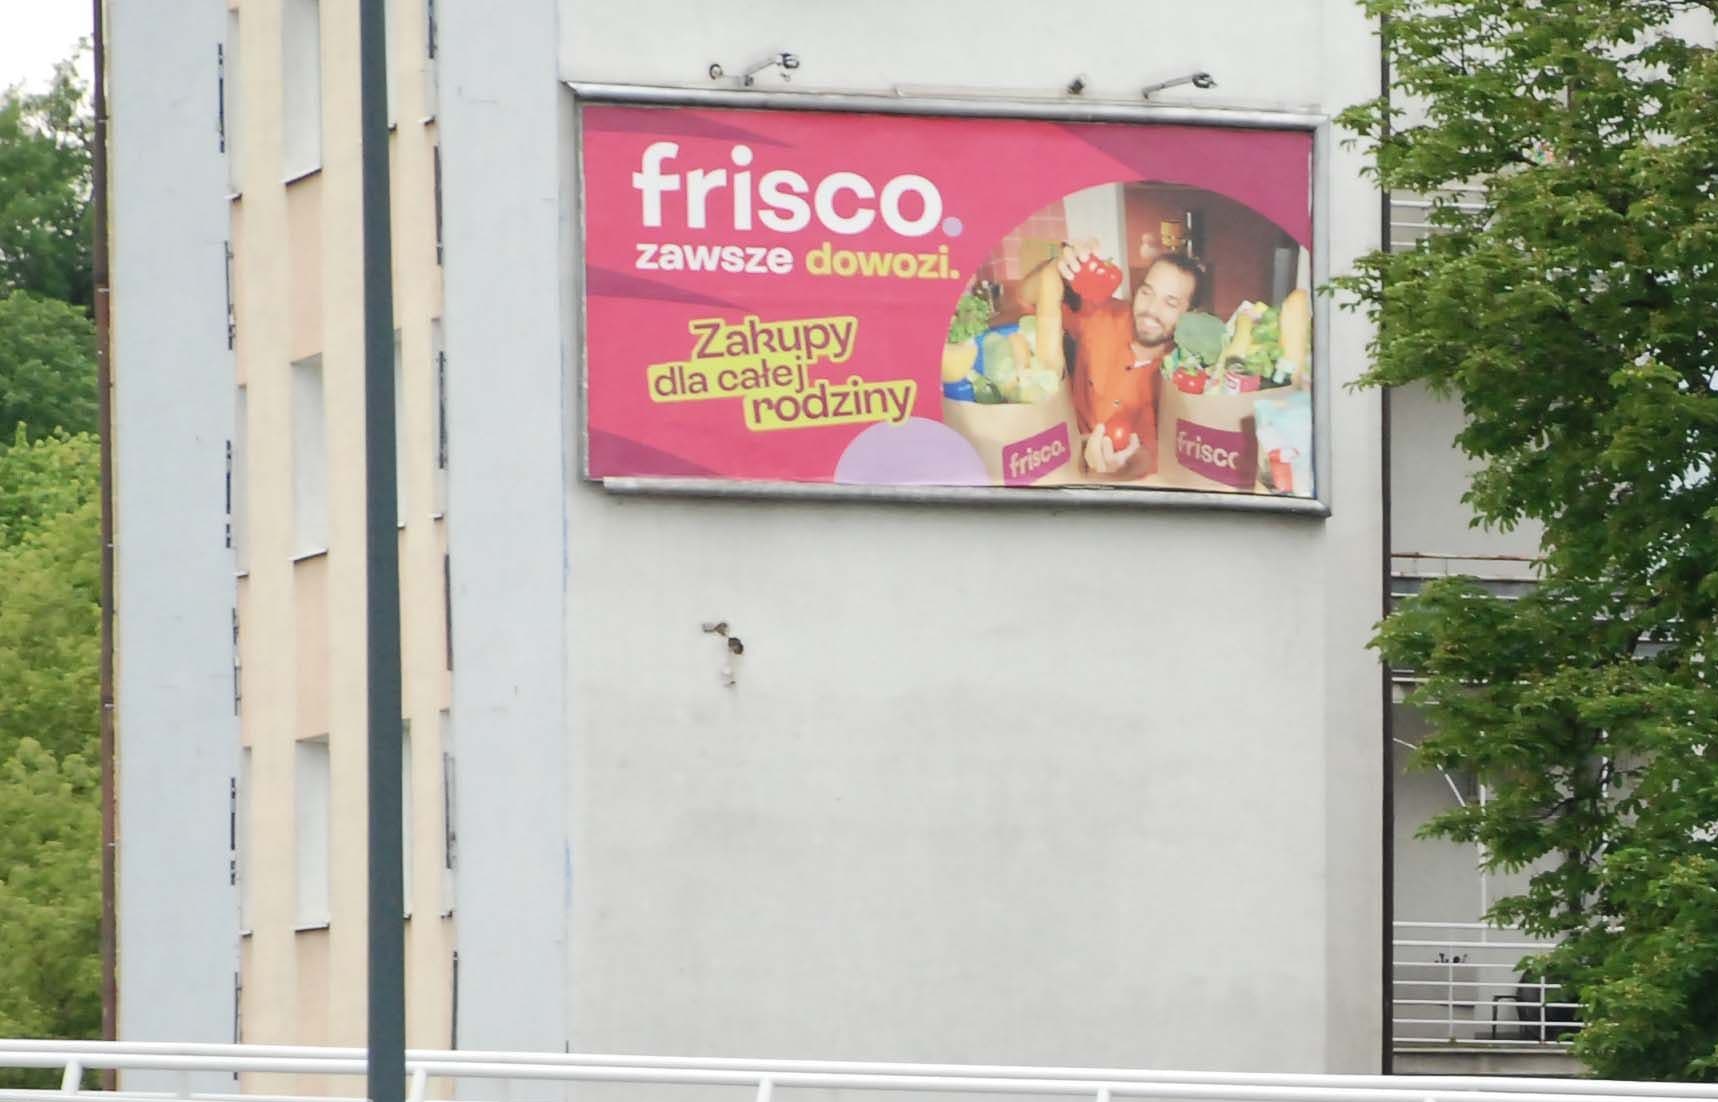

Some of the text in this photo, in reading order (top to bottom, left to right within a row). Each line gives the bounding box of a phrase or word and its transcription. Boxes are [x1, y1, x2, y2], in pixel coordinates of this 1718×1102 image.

[634, 241, 961, 280] zawsze dowozi.
[693, 319, 855, 360] Zakupy
[653, 355, 805, 398] dla całej
[750, 379, 912, 424] rodziny
